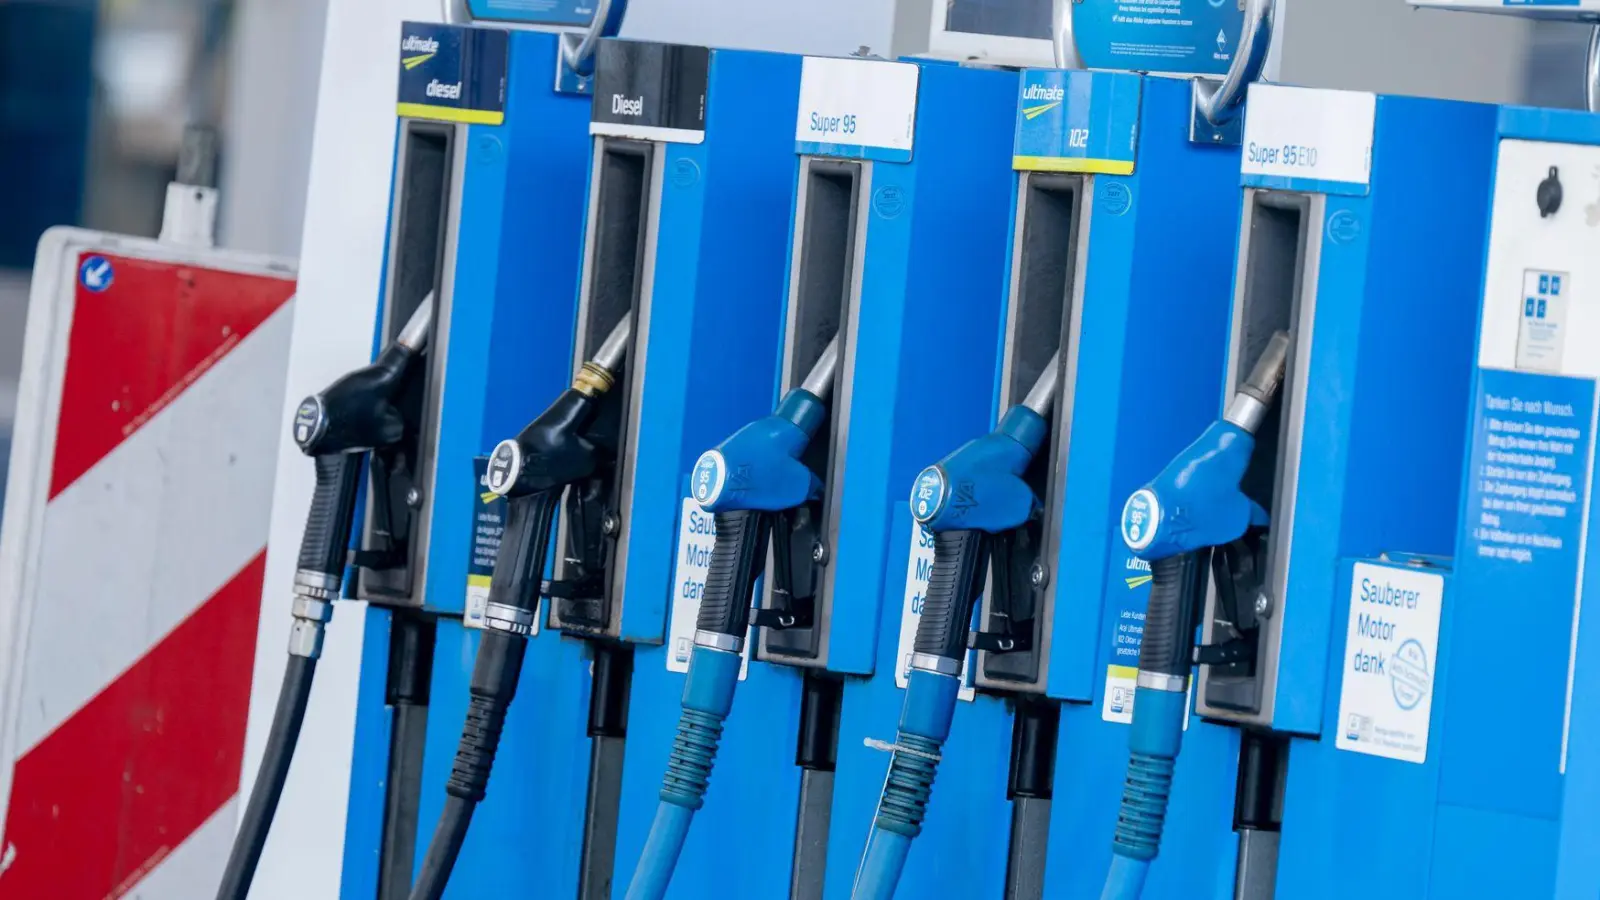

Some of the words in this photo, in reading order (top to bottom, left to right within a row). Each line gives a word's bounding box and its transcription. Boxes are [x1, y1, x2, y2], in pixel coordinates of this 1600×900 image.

[402, 35, 439, 54] ultimate
[426, 79, 461, 100] diesel
[1023, 84, 1064, 101] ultimate
[612, 94, 643, 116] Diesel
[810, 112, 840, 136] Super
[843, 115, 857, 134] 95
[1069, 129, 1089, 148] 102
[1248, 142, 1279, 168] Super
[1282, 145, 1297, 165] 95
[700, 470, 711, 483] 95
[918, 487, 934, 500] 102
[683, 576, 704, 599] dan
[1361, 578, 1420, 610] Sauberer
[1357, 612, 1396, 642] Motor
[1354, 648, 1385, 675] dank
